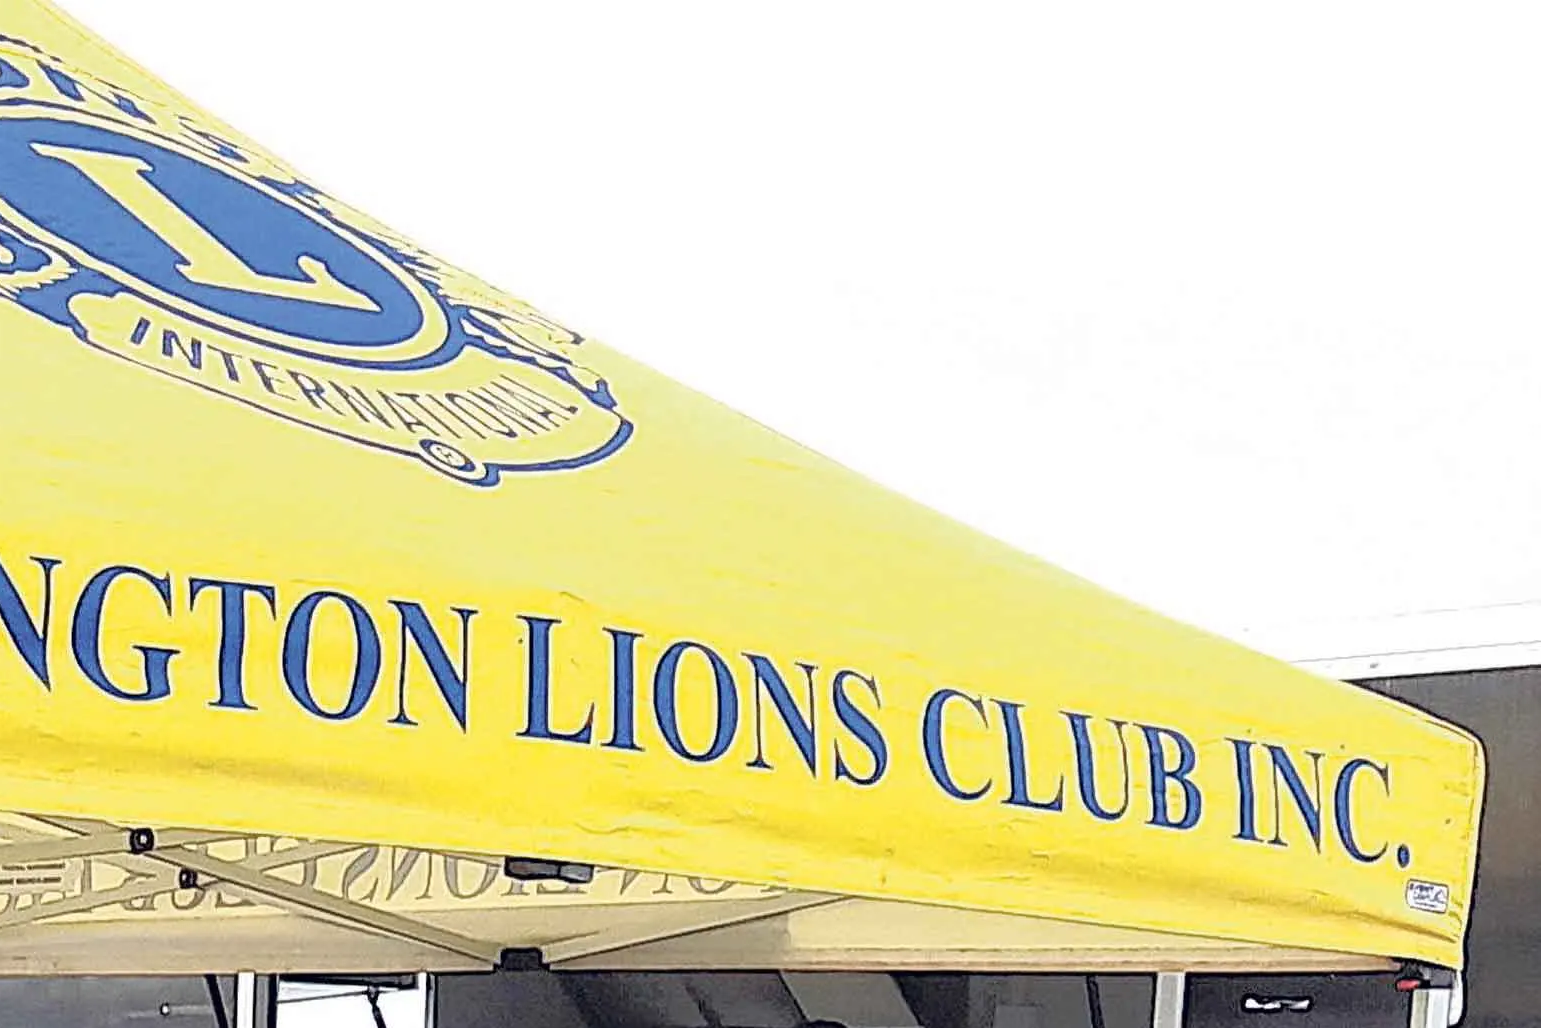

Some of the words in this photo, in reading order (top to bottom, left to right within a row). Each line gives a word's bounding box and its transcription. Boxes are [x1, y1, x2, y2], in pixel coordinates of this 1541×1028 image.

[129, 317, 580, 440] INTERNATIONAL
[515, 612, 889, 787] LIONS
[921, 688, 1204, 831] CLUB
[1225, 737, 1412, 869] INC.
